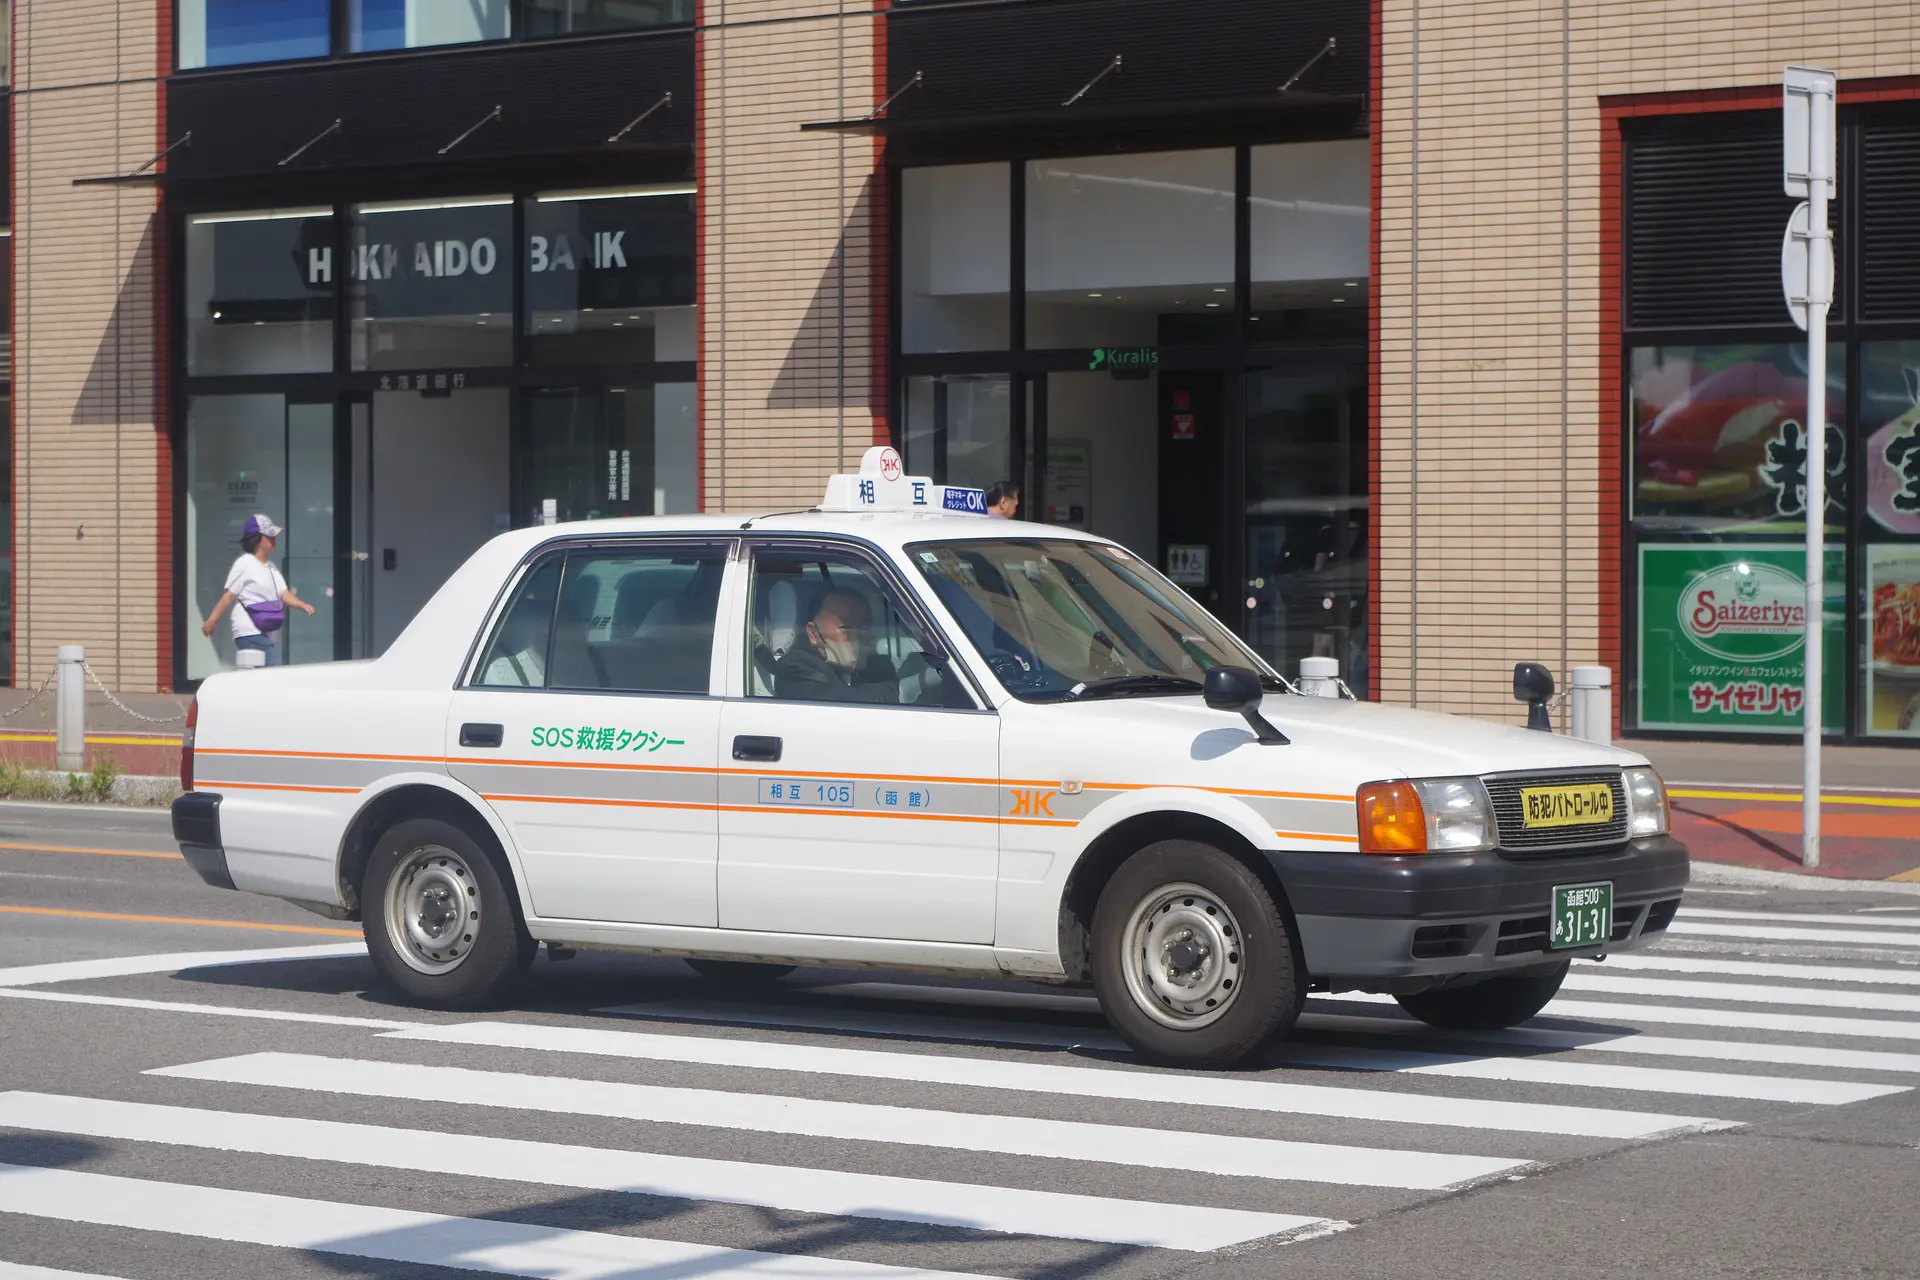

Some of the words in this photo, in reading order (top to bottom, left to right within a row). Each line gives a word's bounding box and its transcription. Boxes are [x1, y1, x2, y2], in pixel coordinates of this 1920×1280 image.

[309, 237, 497, 283] HKKAIDO
[1106, 348, 1159, 364] Kiralis
[946, 490, 967, 500] 電子マネー
[946, 500, 967, 510] クレジット
[966, 491, 985, 511] OK
[1691, 590, 1805, 632] Saizeriya
[1691, 681, 1804, 714] サイゼリヤ
[530, 726, 686, 753] SOS救援タクシー
[816, 785, 850, 803] 105
[1528, 790, 1609, 821] 防犯パトロール中
[1555, 919, 1564, 936] あ
